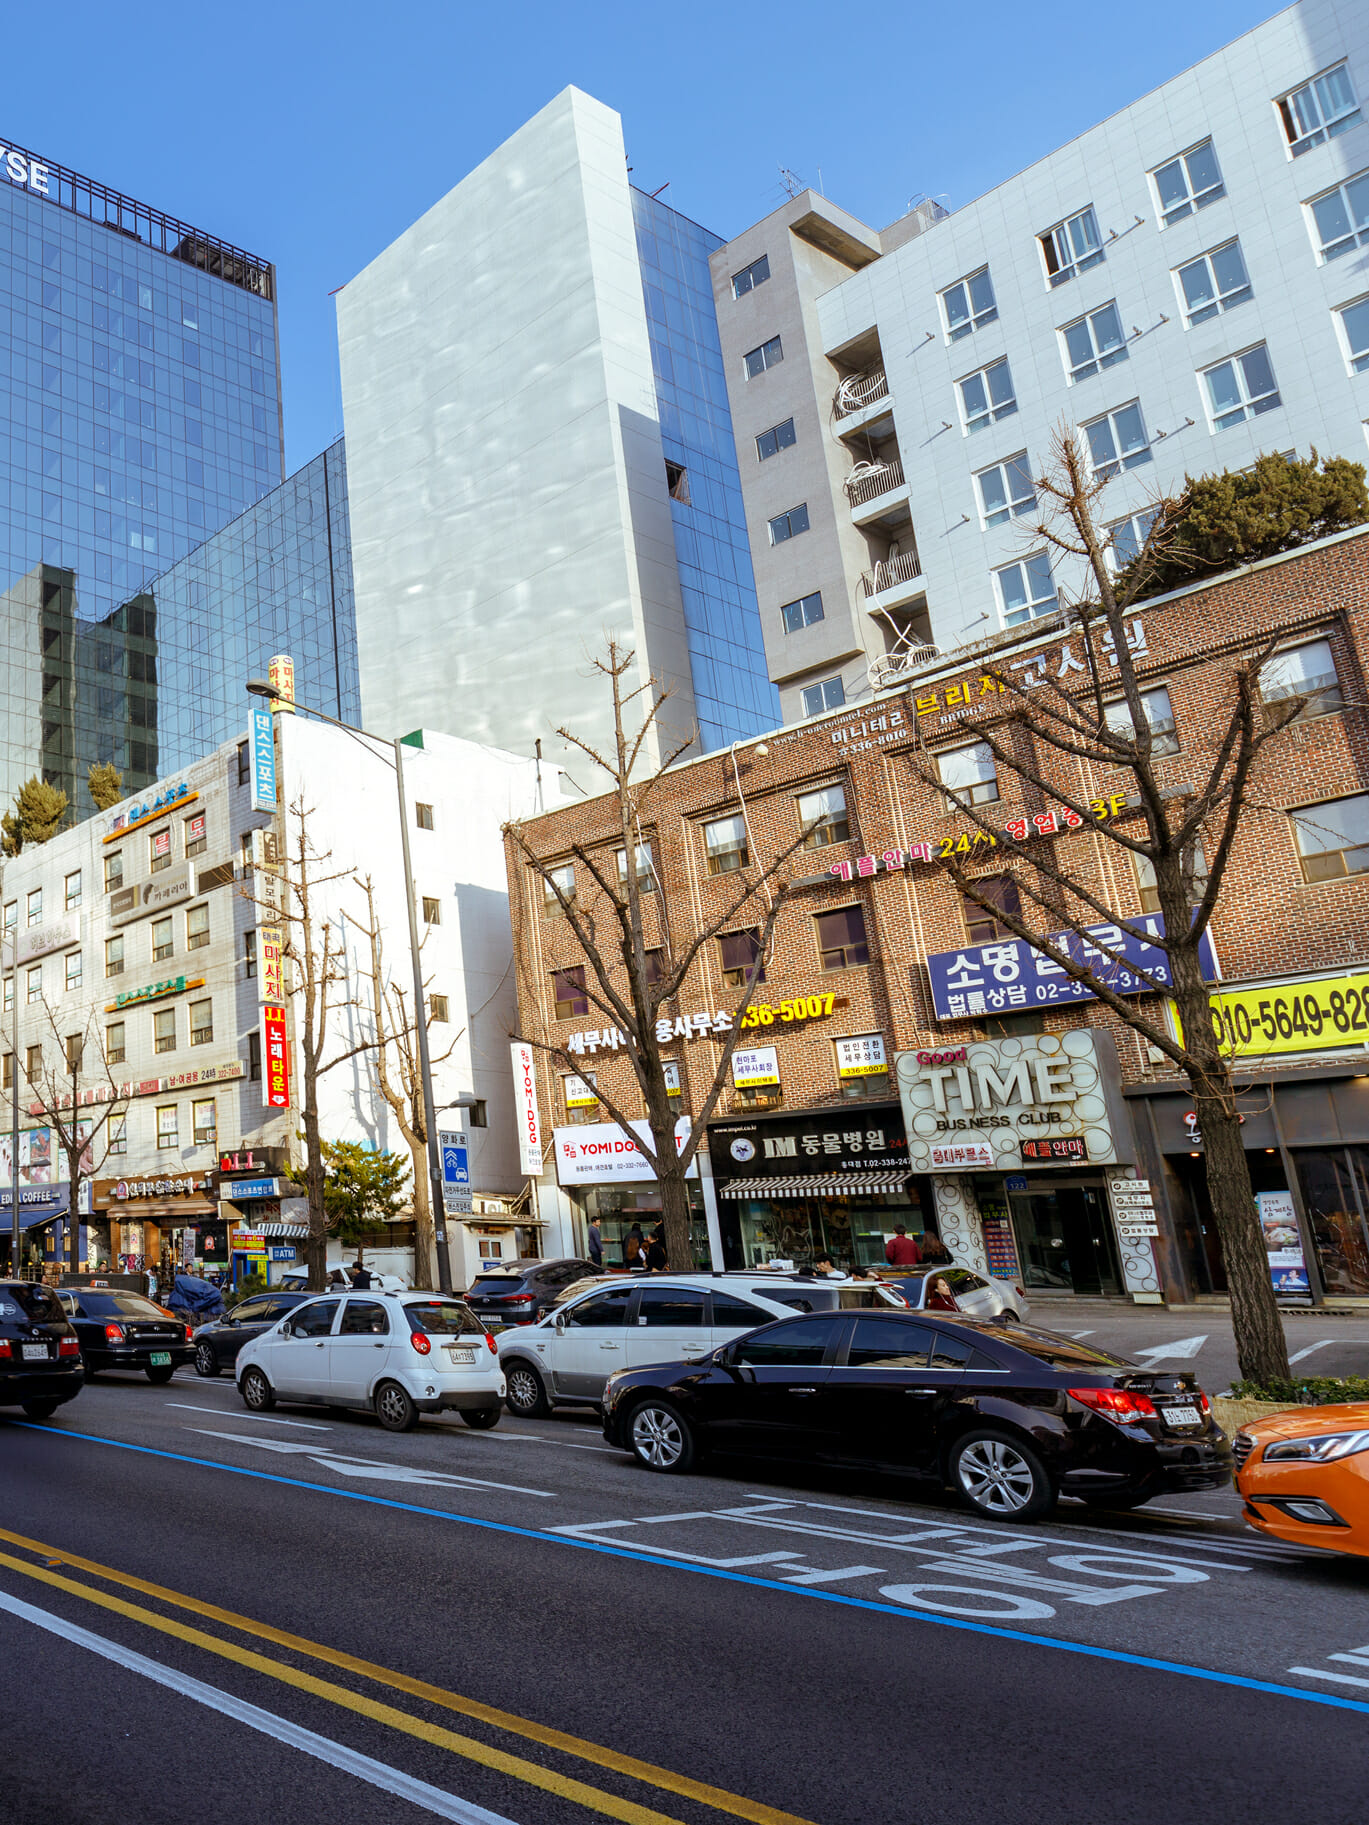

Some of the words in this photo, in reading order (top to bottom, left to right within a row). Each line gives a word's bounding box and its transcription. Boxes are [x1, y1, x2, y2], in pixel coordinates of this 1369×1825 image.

[939, 703, 987, 725] BRIDGE
[255, 714, 274, 800] 댄스스포츠
[830, 842, 933, 882] 애플안마
[939, 831, 997, 858] 24시
[1006, 807, 1084, 841] 영업중
[1089, 793, 1128, 821] 3F
[264, 945, 282, 999] 마사지
[946, 944, 1021, 990] 소명
[734, 993, 836, 1029] 36-5007
[947, 984, 1028, 1014] 법률상담
[269, 1026, 285, 1092] 노래타운
[845, 1051, 881, 1063] 세무상담
[916, 1047, 967, 1066] Good
[845, 1065, 884, 1075] 336-5007
[918, 1055, 1079, 1113] TIME
[936, 1114, 1011, 1131] BUSNESS
[1018, 1111, 1062, 1127] CLUB
[441, 1133, 467, 1145] 양화로
[580, 1142, 612, 1156] YOMI
[762, 1136, 799, 1159] IM
[800, 1129, 887, 1156] 동물병원
[1, 1192, 22, 1204] EDI
[22, 1190, 52, 1203] COFFEE
[279, 1249, 294, 1258] ATM
